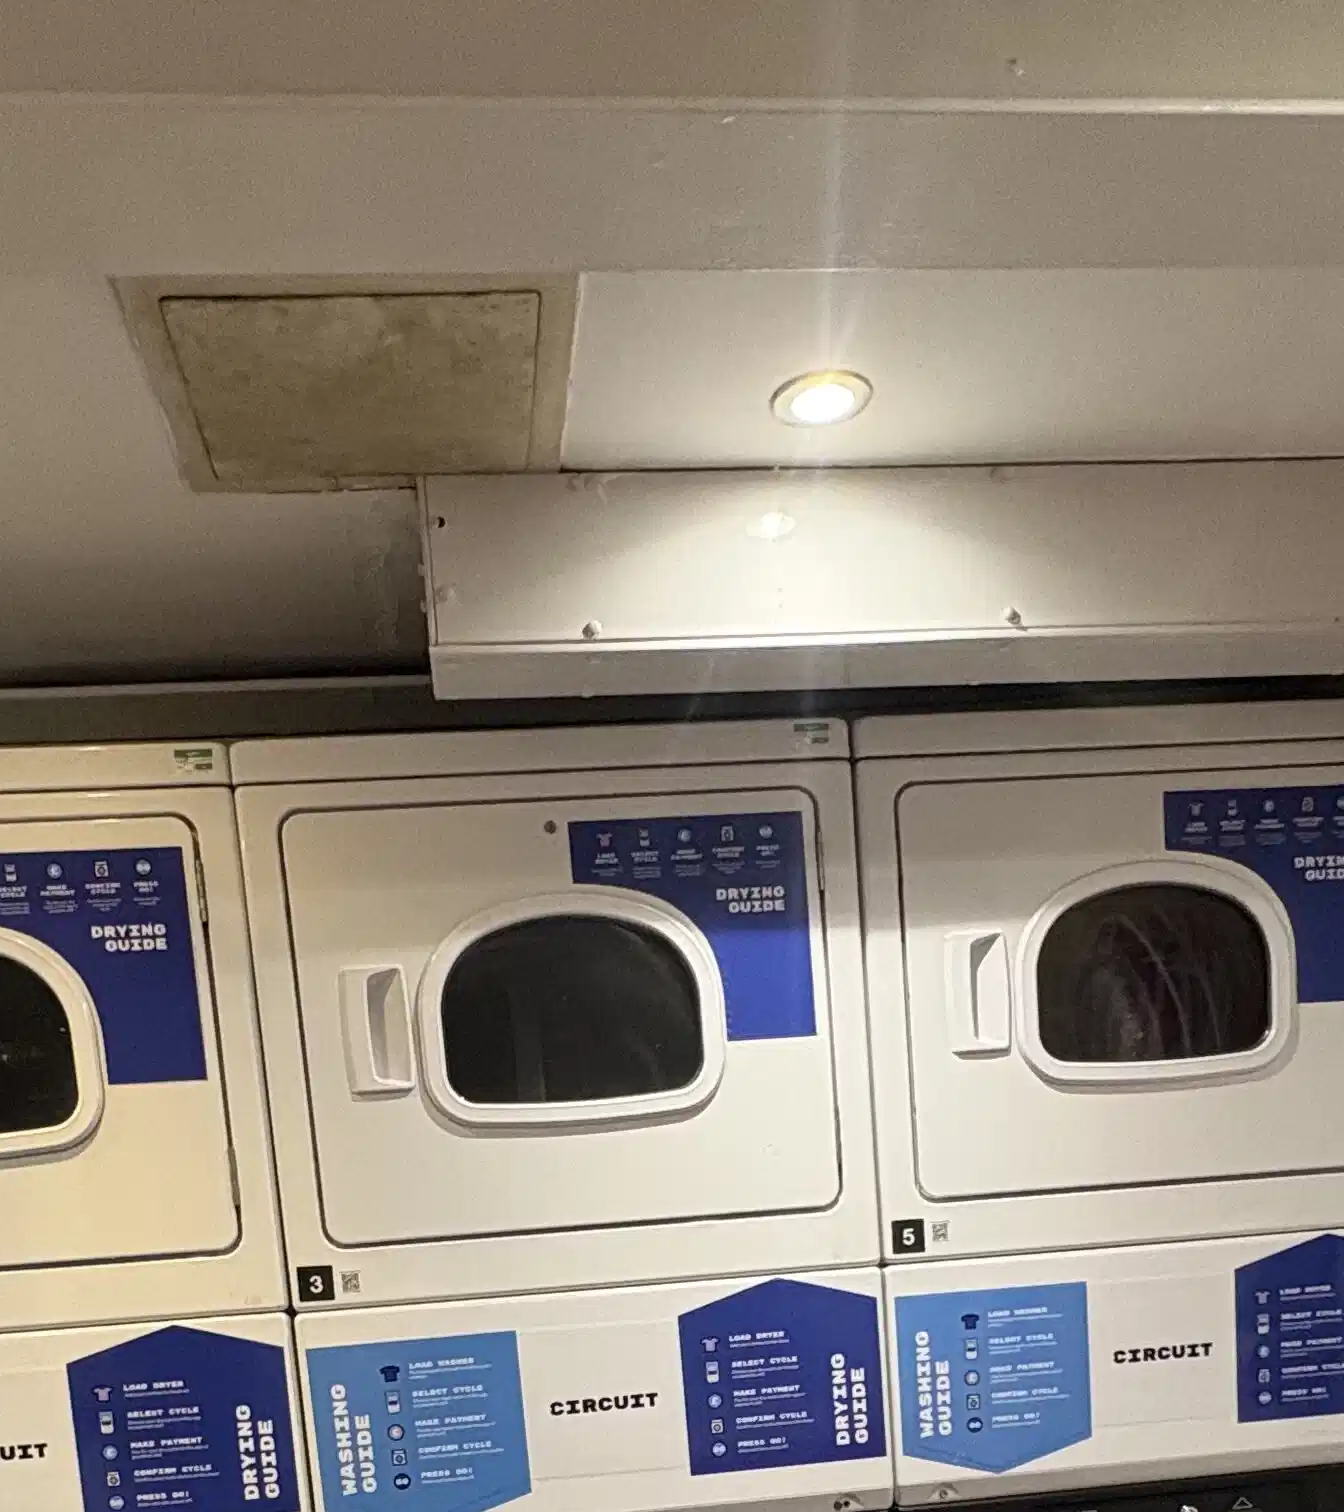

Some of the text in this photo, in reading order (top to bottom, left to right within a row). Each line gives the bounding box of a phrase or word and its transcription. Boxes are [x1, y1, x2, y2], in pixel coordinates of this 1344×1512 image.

[716, 885, 785, 901] DRYING
[728, 899, 785, 913] GUIDE
[91, 922, 167, 938] DRYING
[105, 938, 168, 952] GUIDE
[902, 1228, 915, 1246] 5
[309, 1275, 323, 1293] 3
[1113, 1342, 1213, 1364] CIRCUIT
[550, 1392, 659, 1416] CIRCUIT
[830, 1353, 850, 1446] DRYING
[850, 1367, 868, 1444] GUIDE
[915, 1331, 934, 1439] WASHING
[935, 1360, 952, 1436] GUIDE
[236, 1404, 260, 1500] DRYING
[258, 1420, 280, 1499] GUIDE
[330, 1383, 358, 1496] WASHING
[355, 1414, 377, 1493] GUIDE
